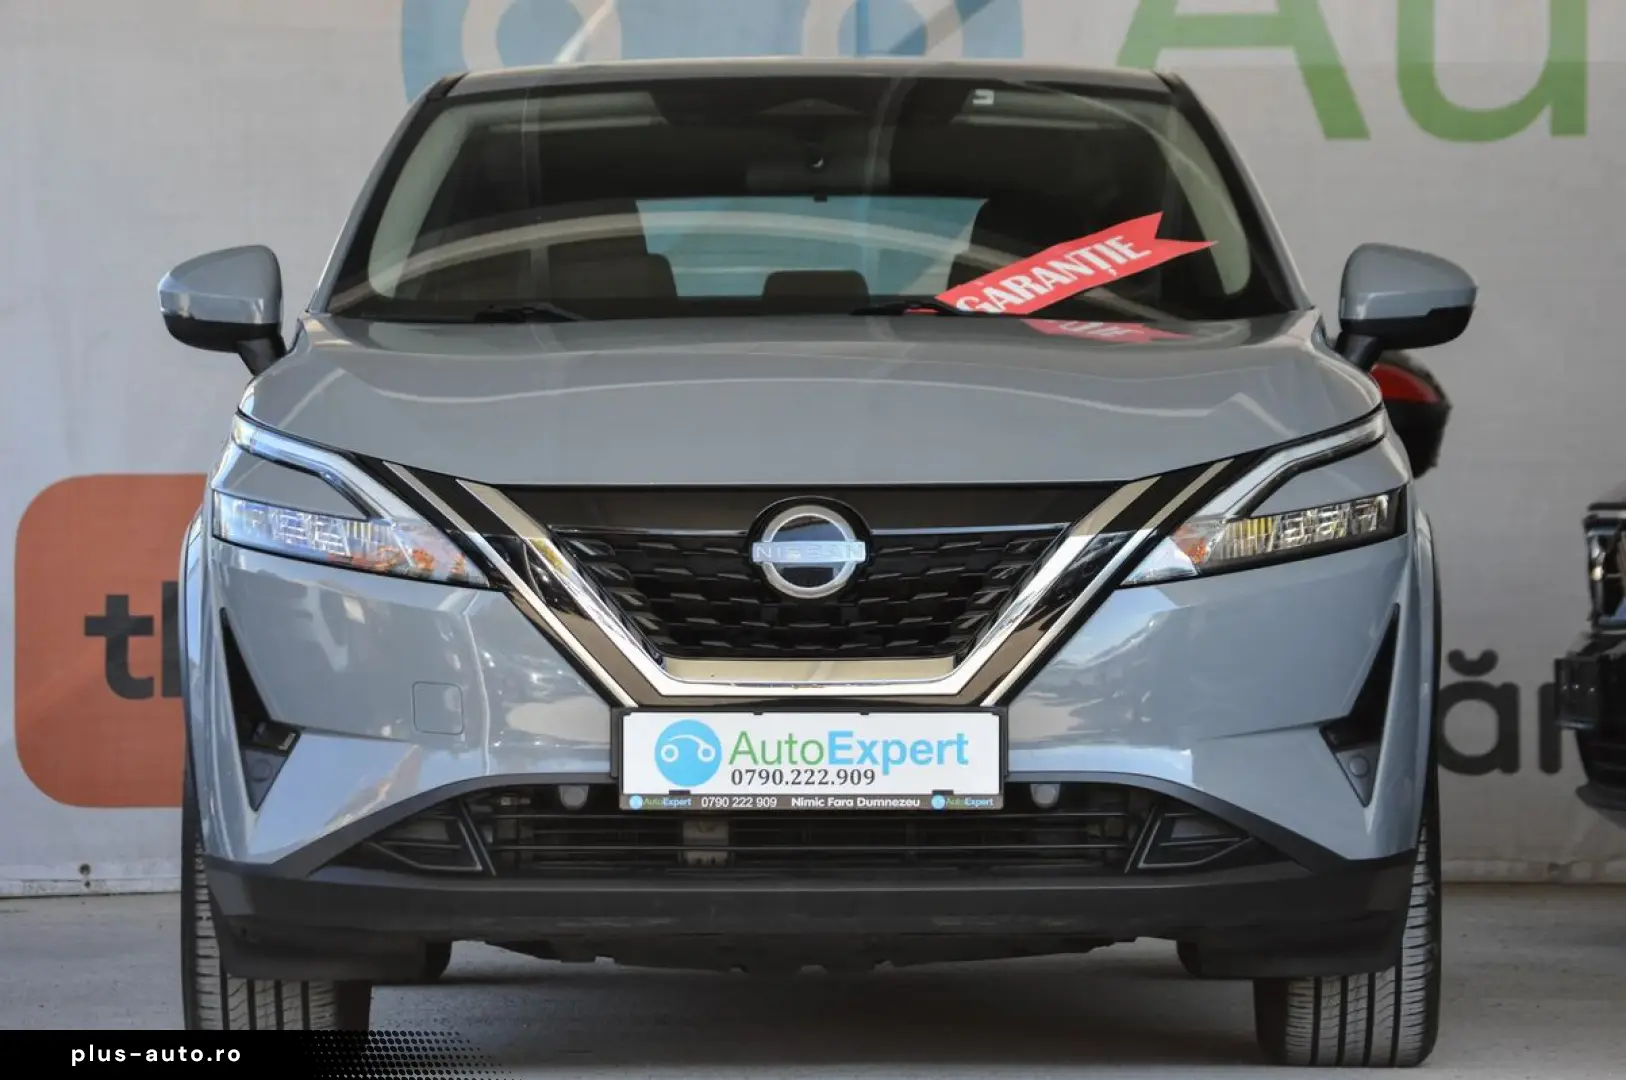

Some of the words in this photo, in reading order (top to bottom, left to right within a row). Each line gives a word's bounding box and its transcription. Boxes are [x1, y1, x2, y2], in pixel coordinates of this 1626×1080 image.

[728, 730, 969, 775] AutoExpert
[731, 768, 876, 786] 0790.222.909
[701, 796, 729, 808] 0790
[732, 796, 753, 808] 222
[756, 796, 777, 808] 909
[791, 796, 824, 808] Nimic
[827, 796, 854, 808] Fara
[856, 796, 920, 808] Dumnezeu
